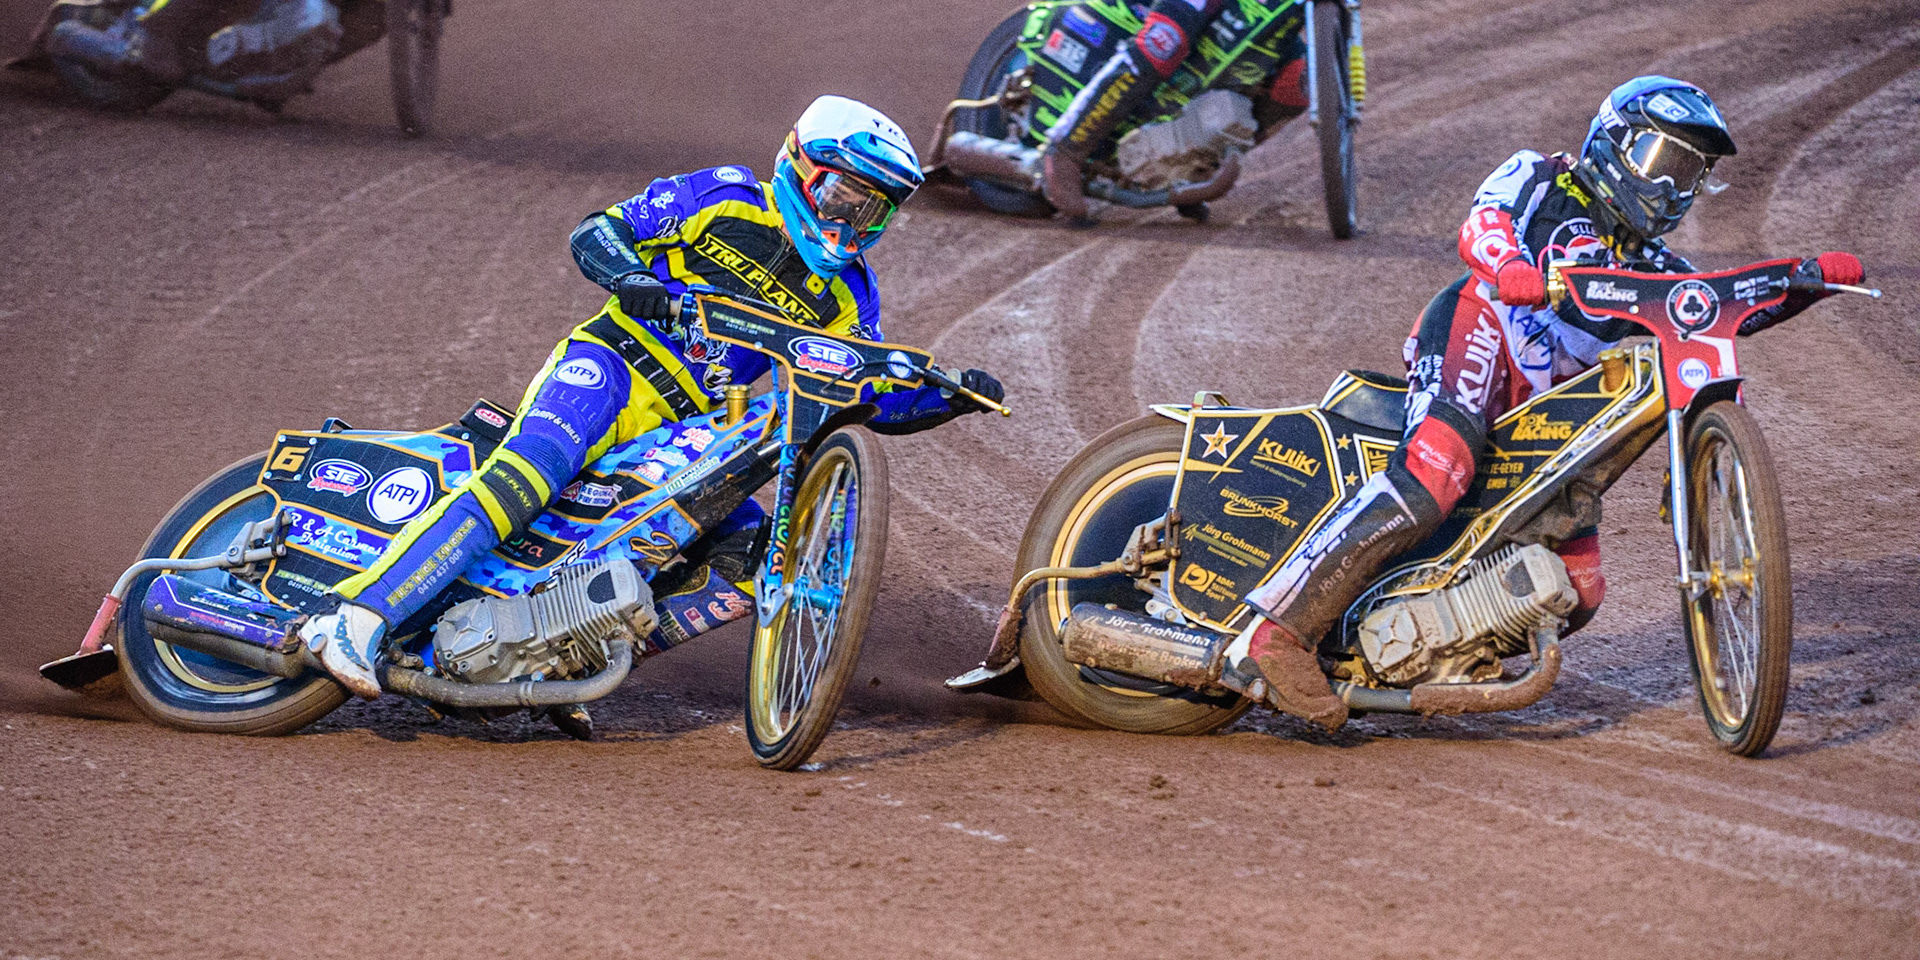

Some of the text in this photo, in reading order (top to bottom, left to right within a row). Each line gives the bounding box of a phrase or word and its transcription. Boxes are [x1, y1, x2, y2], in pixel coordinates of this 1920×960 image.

[705, 240, 812, 325] TRU PLANT
[807, 342, 848, 366] STE
[562, 365, 597, 381] ATPI
[560, 421, 582, 445] JULES
[1510, 424, 1573, 441] RACING
[270, 446, 310, 472] 6
[323, 465, 361, 486] STE
[378, 482, 420, 506] ATPI
[1219, 488, 1299, 530] BRUNKHORST
[289, 511, 303, 528] R
[302, 517, 316, 532] &
[314, 525, 335, 539] A
[300, 531, 360, 562] Irrigation
[1202, 523, 1271, 561] Jörg Grohmann
[386, 557, 438, 609] PRESTIGE
[433, 516, 478, 563] EDGING
[417, 548, 465, 595] 0419 437 005
[1216, 575, 1236, 589] ADAC
[1205, 588, 1226, 602] Sport
